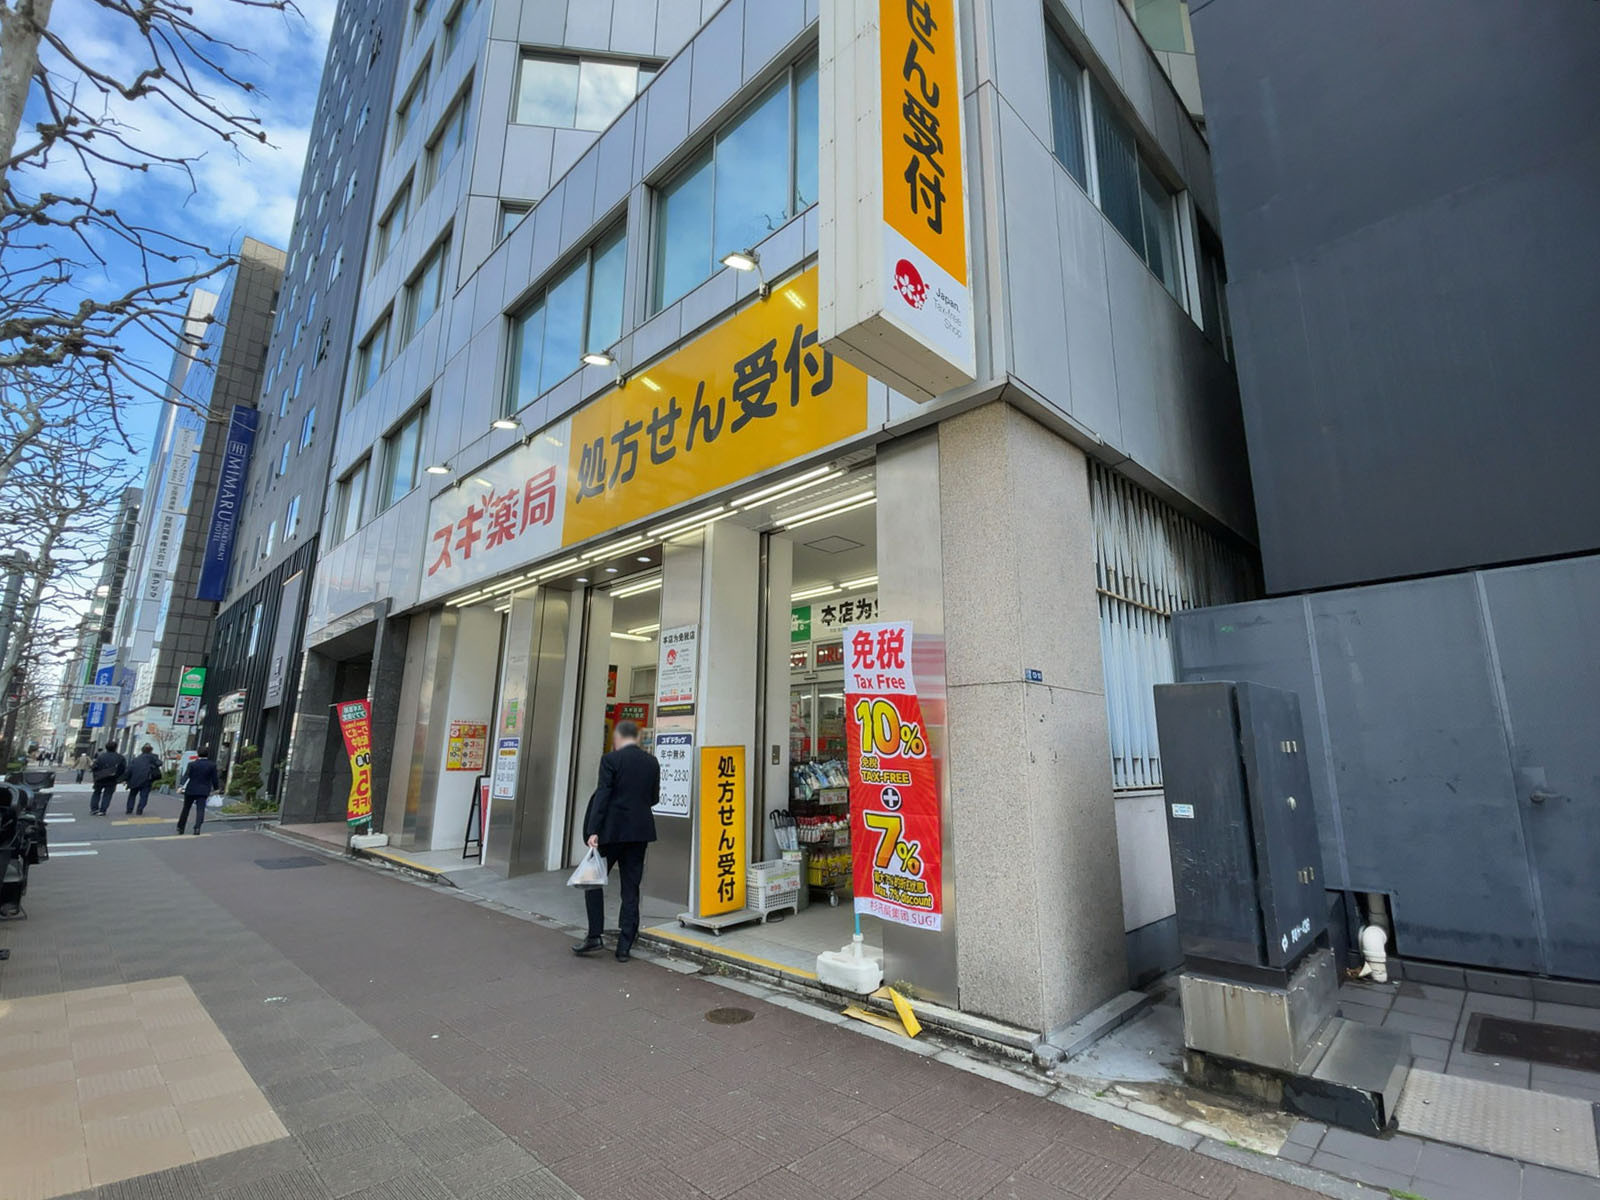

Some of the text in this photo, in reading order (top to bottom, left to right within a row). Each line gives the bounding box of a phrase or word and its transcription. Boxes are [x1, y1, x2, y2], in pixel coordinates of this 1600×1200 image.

[575, 324, 834, 504] 処方せん受付
[217, 455, 242, 521] MIMARU
[427, 464, 557, 577] スギ薬局
[851, 628, 905, 670] 免税
[853, 674, 906, 690] Tax Free
[856, 699, 925, 755] 10%
[861, 770, 911, 785] TAX-FREE
[717, 755, 736, 904] 処方せん受付
[864, 812, 921, 876] 7%
[900, 891, 932, 908] discount
